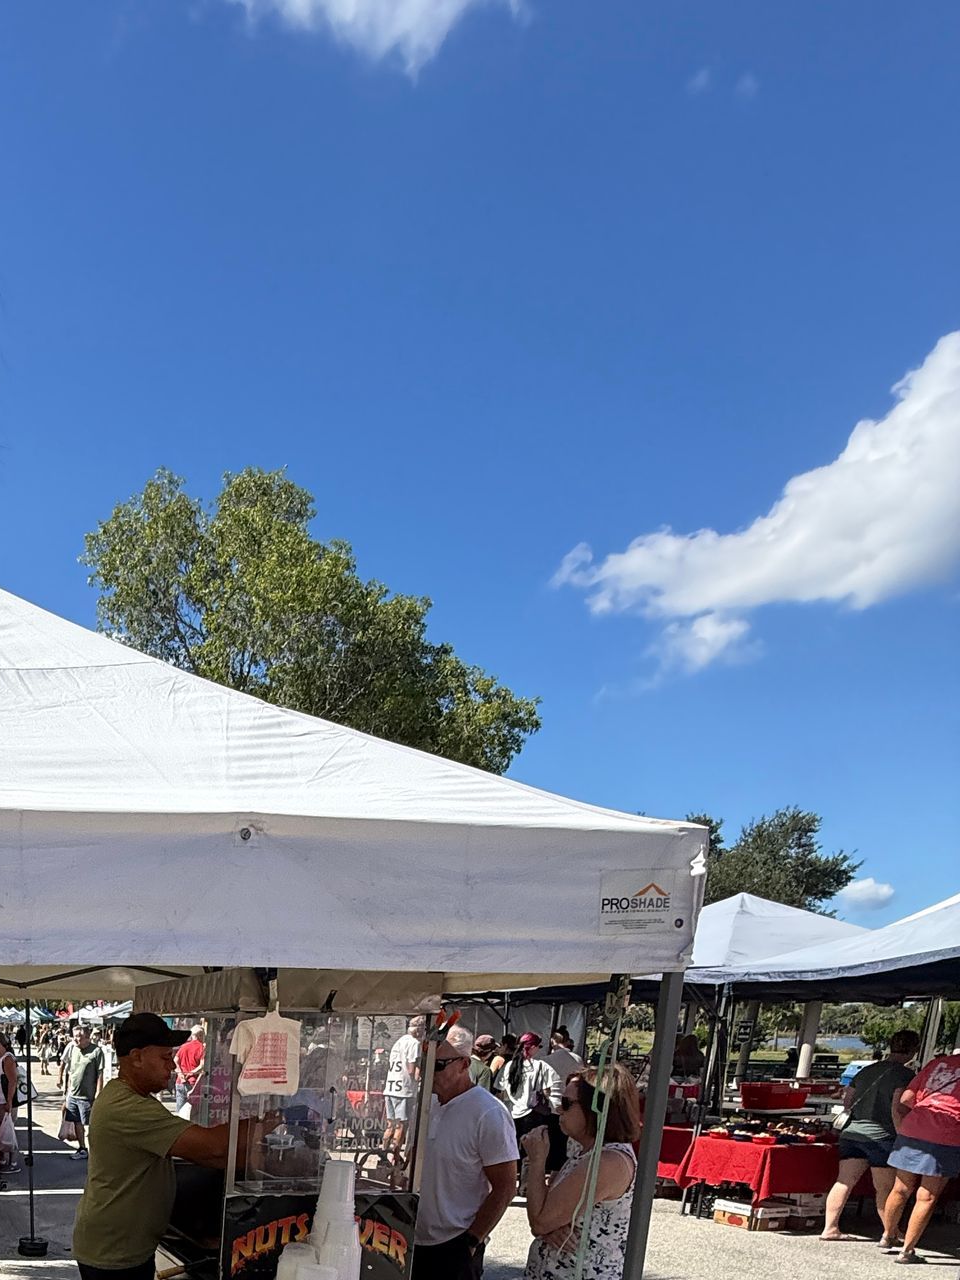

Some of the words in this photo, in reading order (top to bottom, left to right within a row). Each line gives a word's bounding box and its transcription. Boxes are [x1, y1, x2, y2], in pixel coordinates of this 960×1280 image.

[601, 897, 670, 910] PROSHADE
[334, 1118, 398, 1130] ALMOND
[332, 1138, 397, 1150] PEANU
[230, 1213, 310, 1276] NUTS
